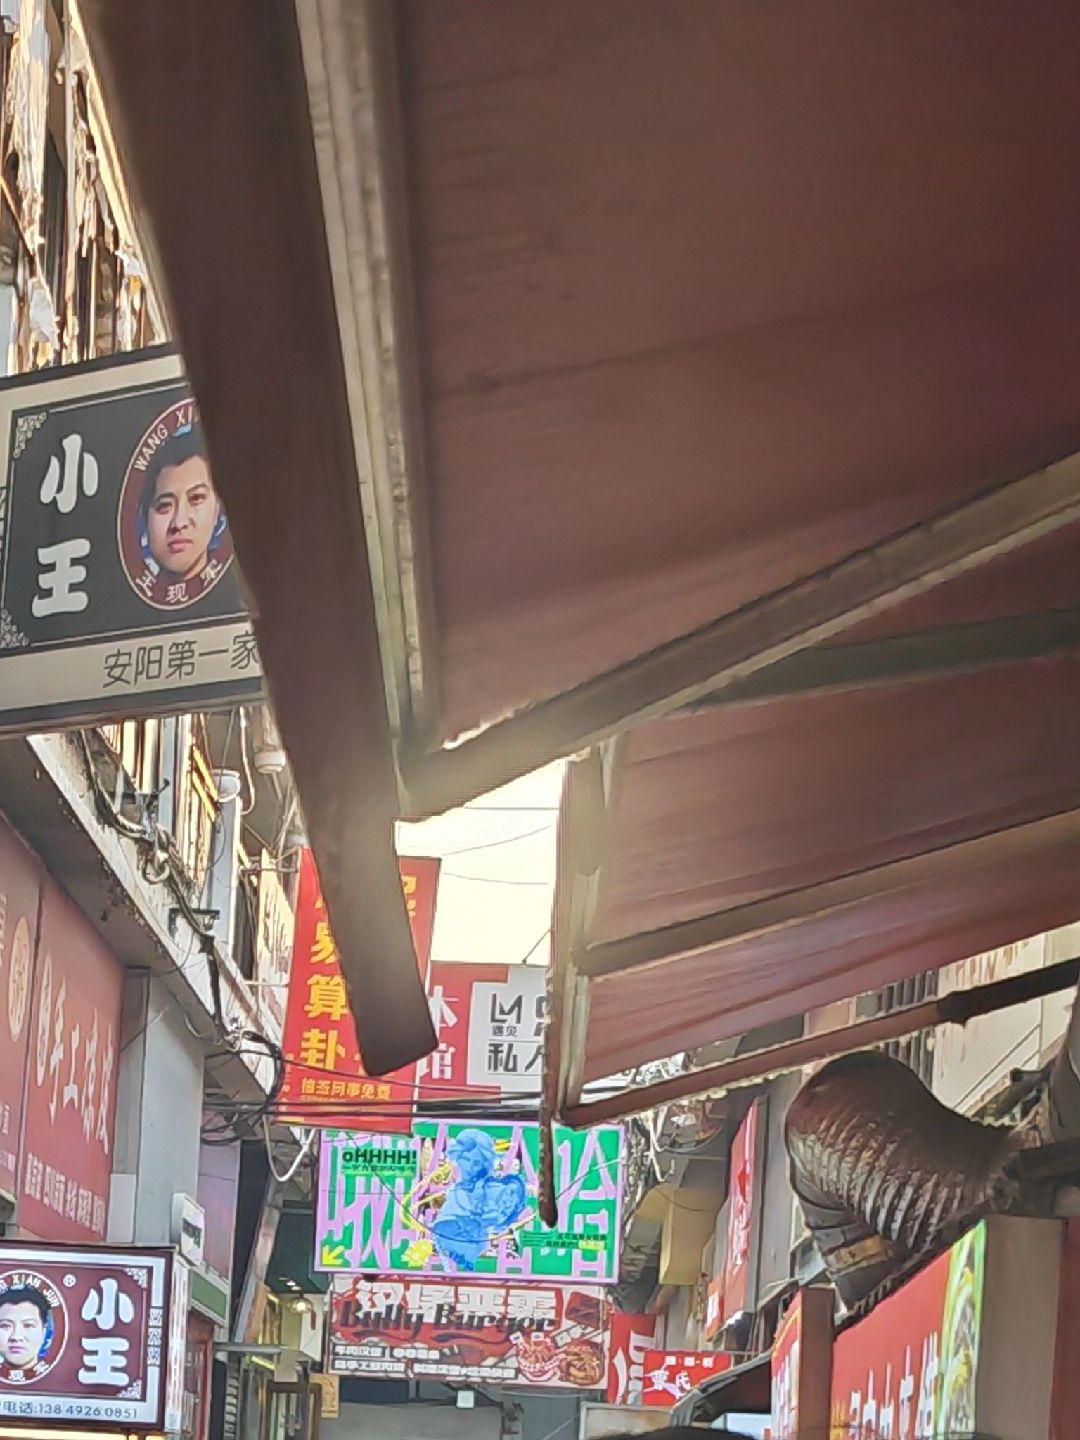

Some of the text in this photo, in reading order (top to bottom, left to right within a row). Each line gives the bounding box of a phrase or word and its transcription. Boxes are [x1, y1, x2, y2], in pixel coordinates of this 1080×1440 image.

[32, 433, 99, 618] 小王
[102, 628, 260, 689] 安阳第一家
[78, 1278, 135, 1386] 小王
